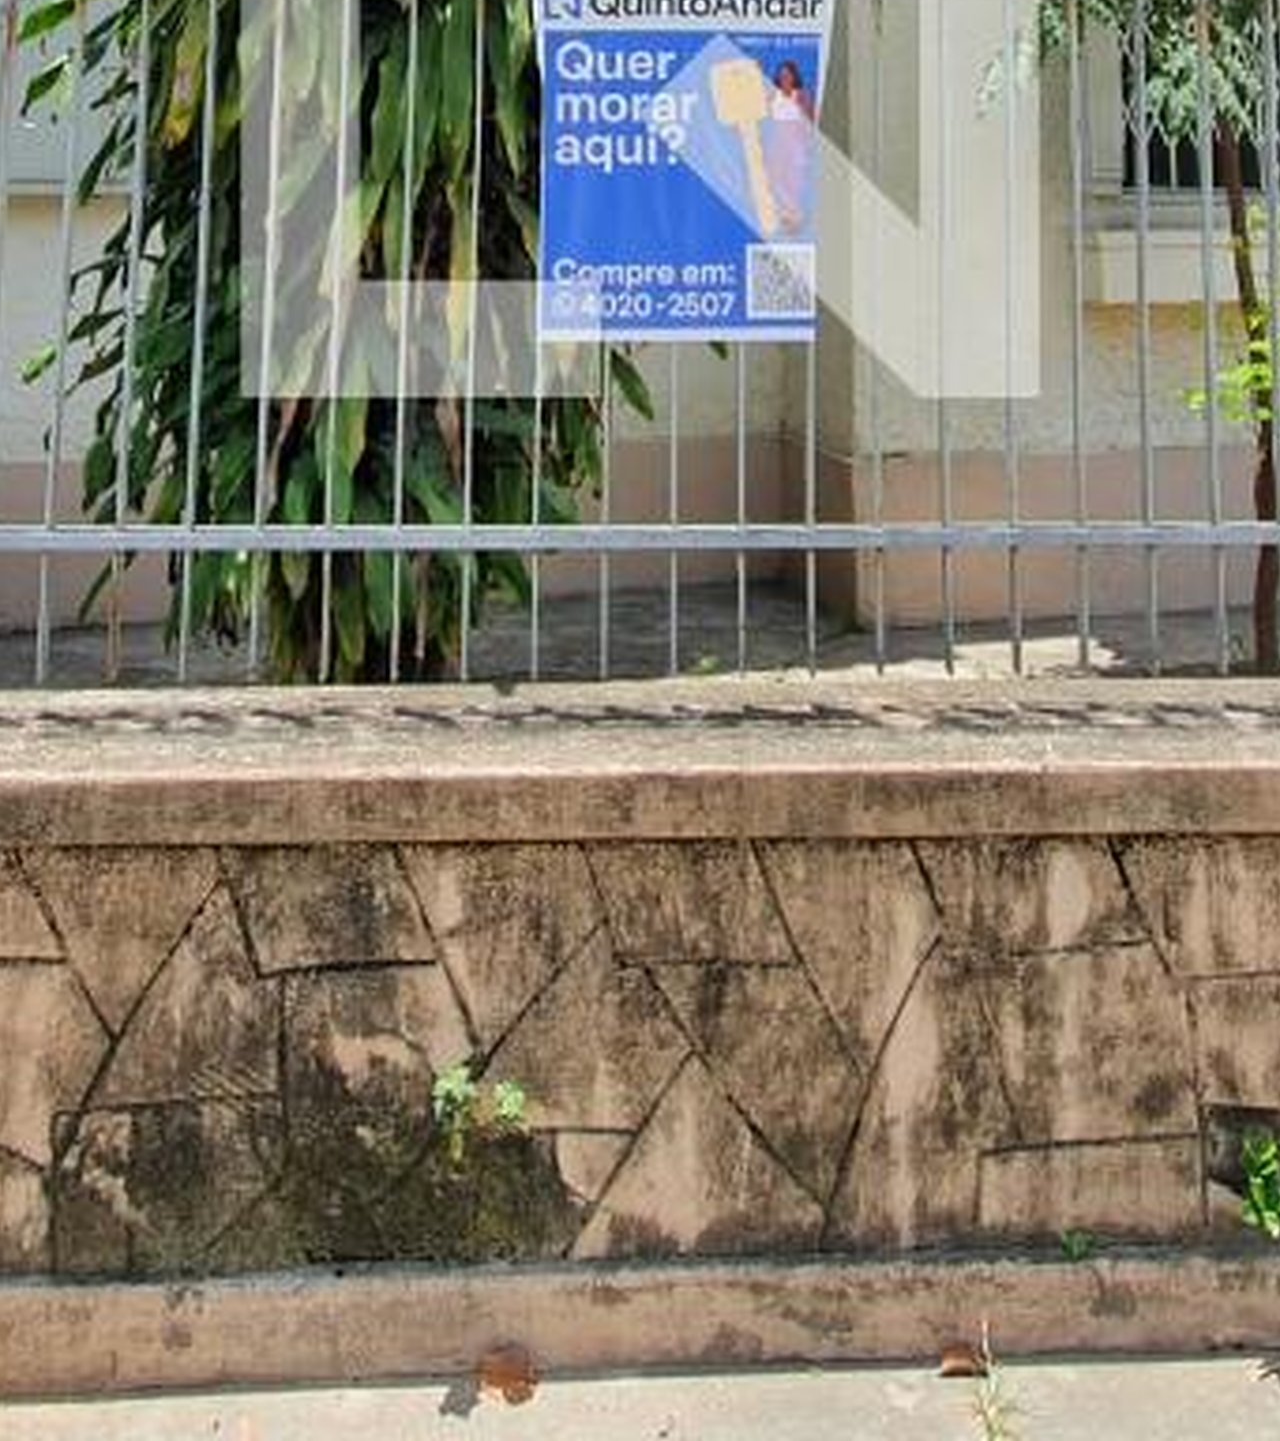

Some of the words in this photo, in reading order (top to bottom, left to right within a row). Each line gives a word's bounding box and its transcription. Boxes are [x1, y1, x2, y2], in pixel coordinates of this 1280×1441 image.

[556, 40, 677, 81] Quer
[556, 91, 699, 124] morar
[555, 124, 685, 173] aqui?
[553, 257, 675, 289] Compre
[681, 262, 736, 286] em:
